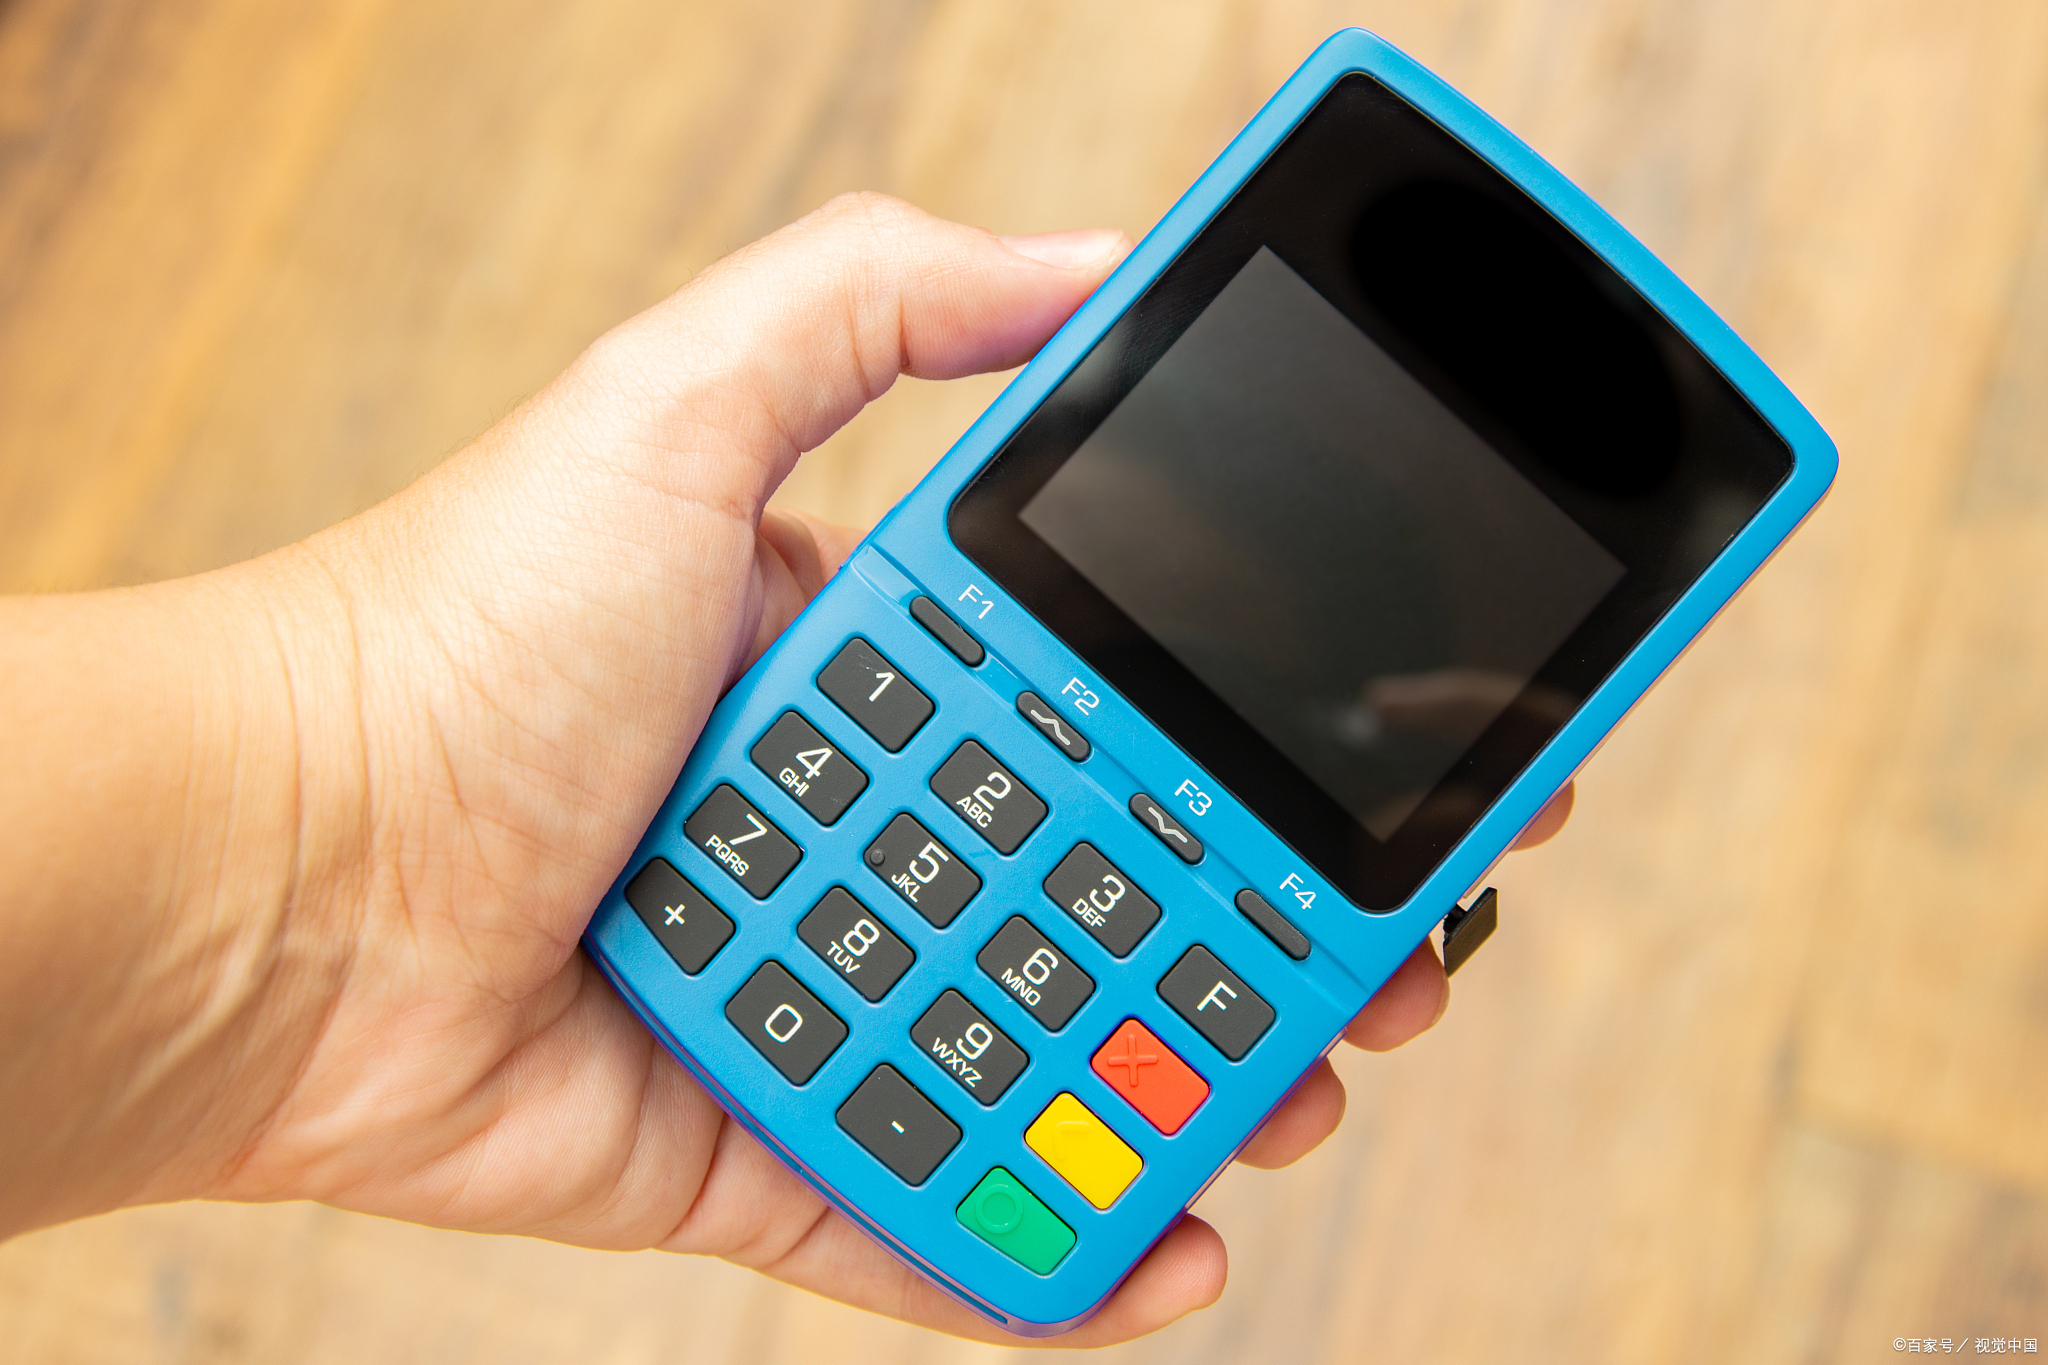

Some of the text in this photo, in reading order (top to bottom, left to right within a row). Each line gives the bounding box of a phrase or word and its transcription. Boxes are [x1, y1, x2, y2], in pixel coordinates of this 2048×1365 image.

[957, 584, 995, 620] F1
[869, 672, 895, 701] 1
[1061, 677, 1100, 716] F2
[778, 767, 810, 797] GHI
[796, 748, 833, 779] 4
[973, 771, 1012, 810] 2
[1174, 779, 1212, 816] F3
[729, 814, 768, 845] 7
[956, 795, 993, 829] ABC
[705, 835, 749, 876] PQRS
[909, 841, 949, 883] 5
[891, 873, 920, 902] JKL
[1089, 874, 1126, 913] 3
[1279, 872, 1317, 910] F4
[1072, 898, 1106, 929] DEF
[843, 918, 880, 957] 8
[826, 941, 861, 975] TUV
[1022, 948, 1059, 985] 6
[1001, 968, 1041, 1007] MNO
[1196, 980, 1237, 1012] F
[956, 1022, 993, 1060] 9
[932, 1037, 983, 1088] WXYZ
